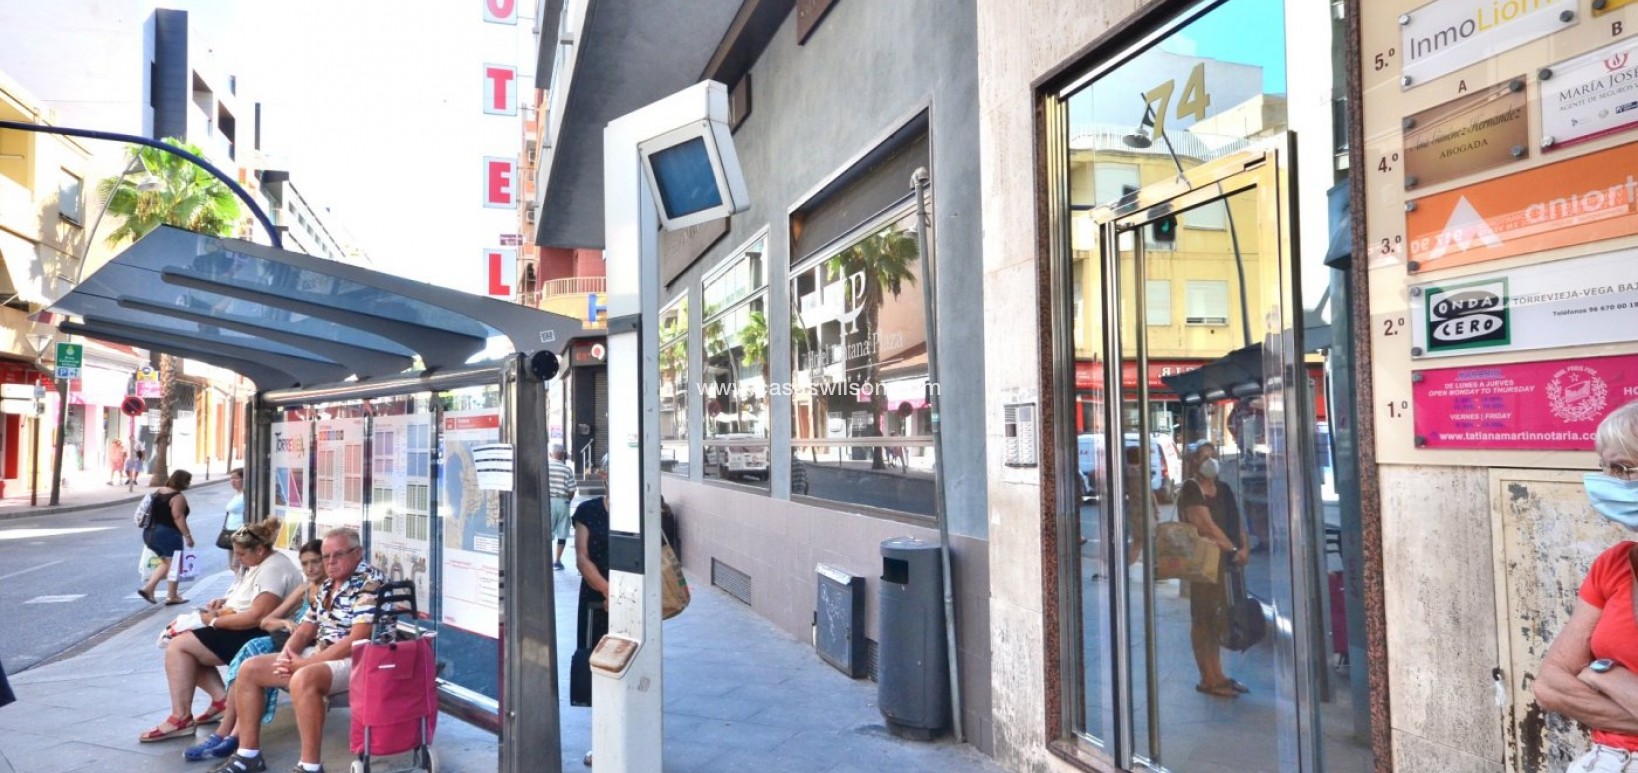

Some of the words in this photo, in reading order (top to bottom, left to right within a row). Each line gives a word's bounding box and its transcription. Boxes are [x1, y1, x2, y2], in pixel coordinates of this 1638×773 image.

[1611, 21, 1623, 37] B
[1458, 80, 1467, 93] A
[1560, 80, 1604, 102] MARÍA
[1145, 62, 1211, 141] 74
[1439, 138, 1488, 159] ABOGADA
[1512, 285, 1614, 306] TORREVIEJA-VEGA
[1438, 296, 1493, 315] ONDA
[1442, 319, 1494, 336] CERO
[1448, 388, 1480, 396] MONDAY
[1493, 385, 1536, 393] THURSDAY
[1455, 381, 1478, 389] LUNES
